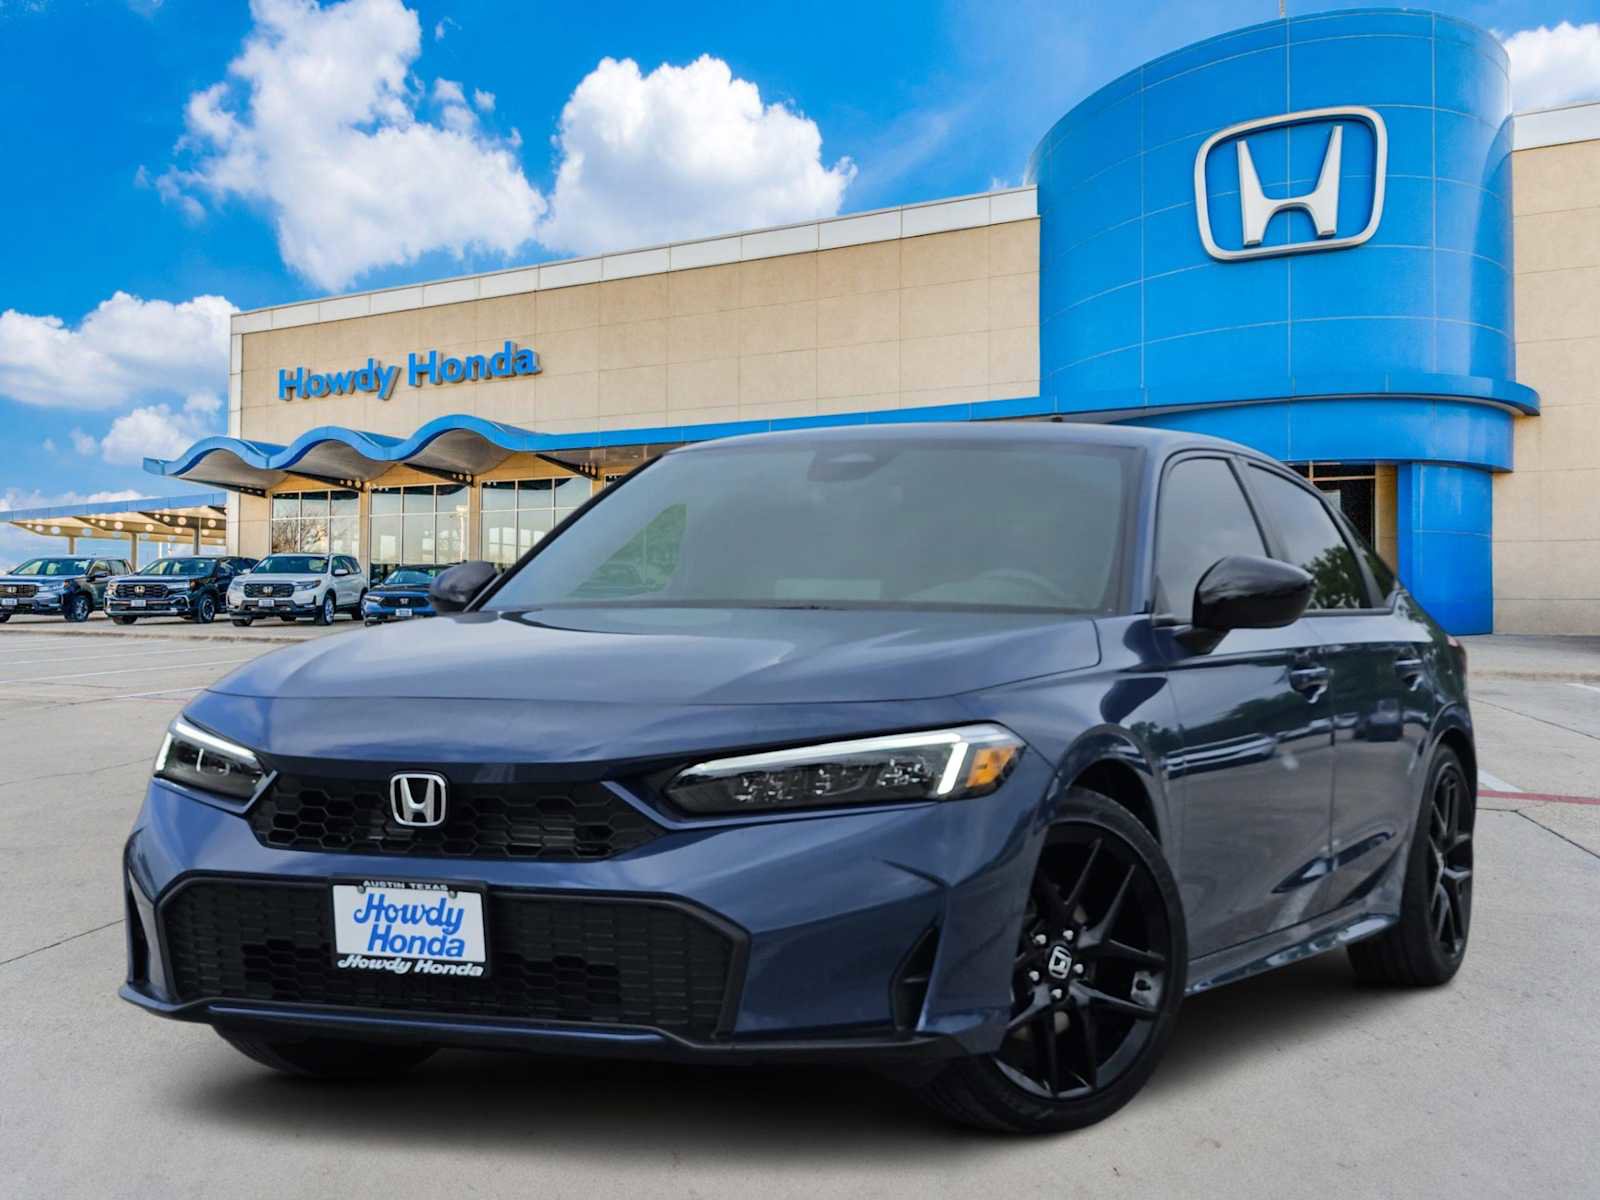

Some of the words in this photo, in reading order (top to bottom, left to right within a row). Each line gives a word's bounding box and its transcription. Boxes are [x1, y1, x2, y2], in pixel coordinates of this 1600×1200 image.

[278, 358, 401, 401] Howdy
[408, 340, 541, 387] Honda
[363, 880, 405, 889] AUSTIN
[409, 882, 448, 891] TEXAS
[353, 893, 465, 935] Howdy
[367, 924, 465, 957] Honda
[337, 954, 412, 975] Howdy
[413, 960, 484, 977] Honda
